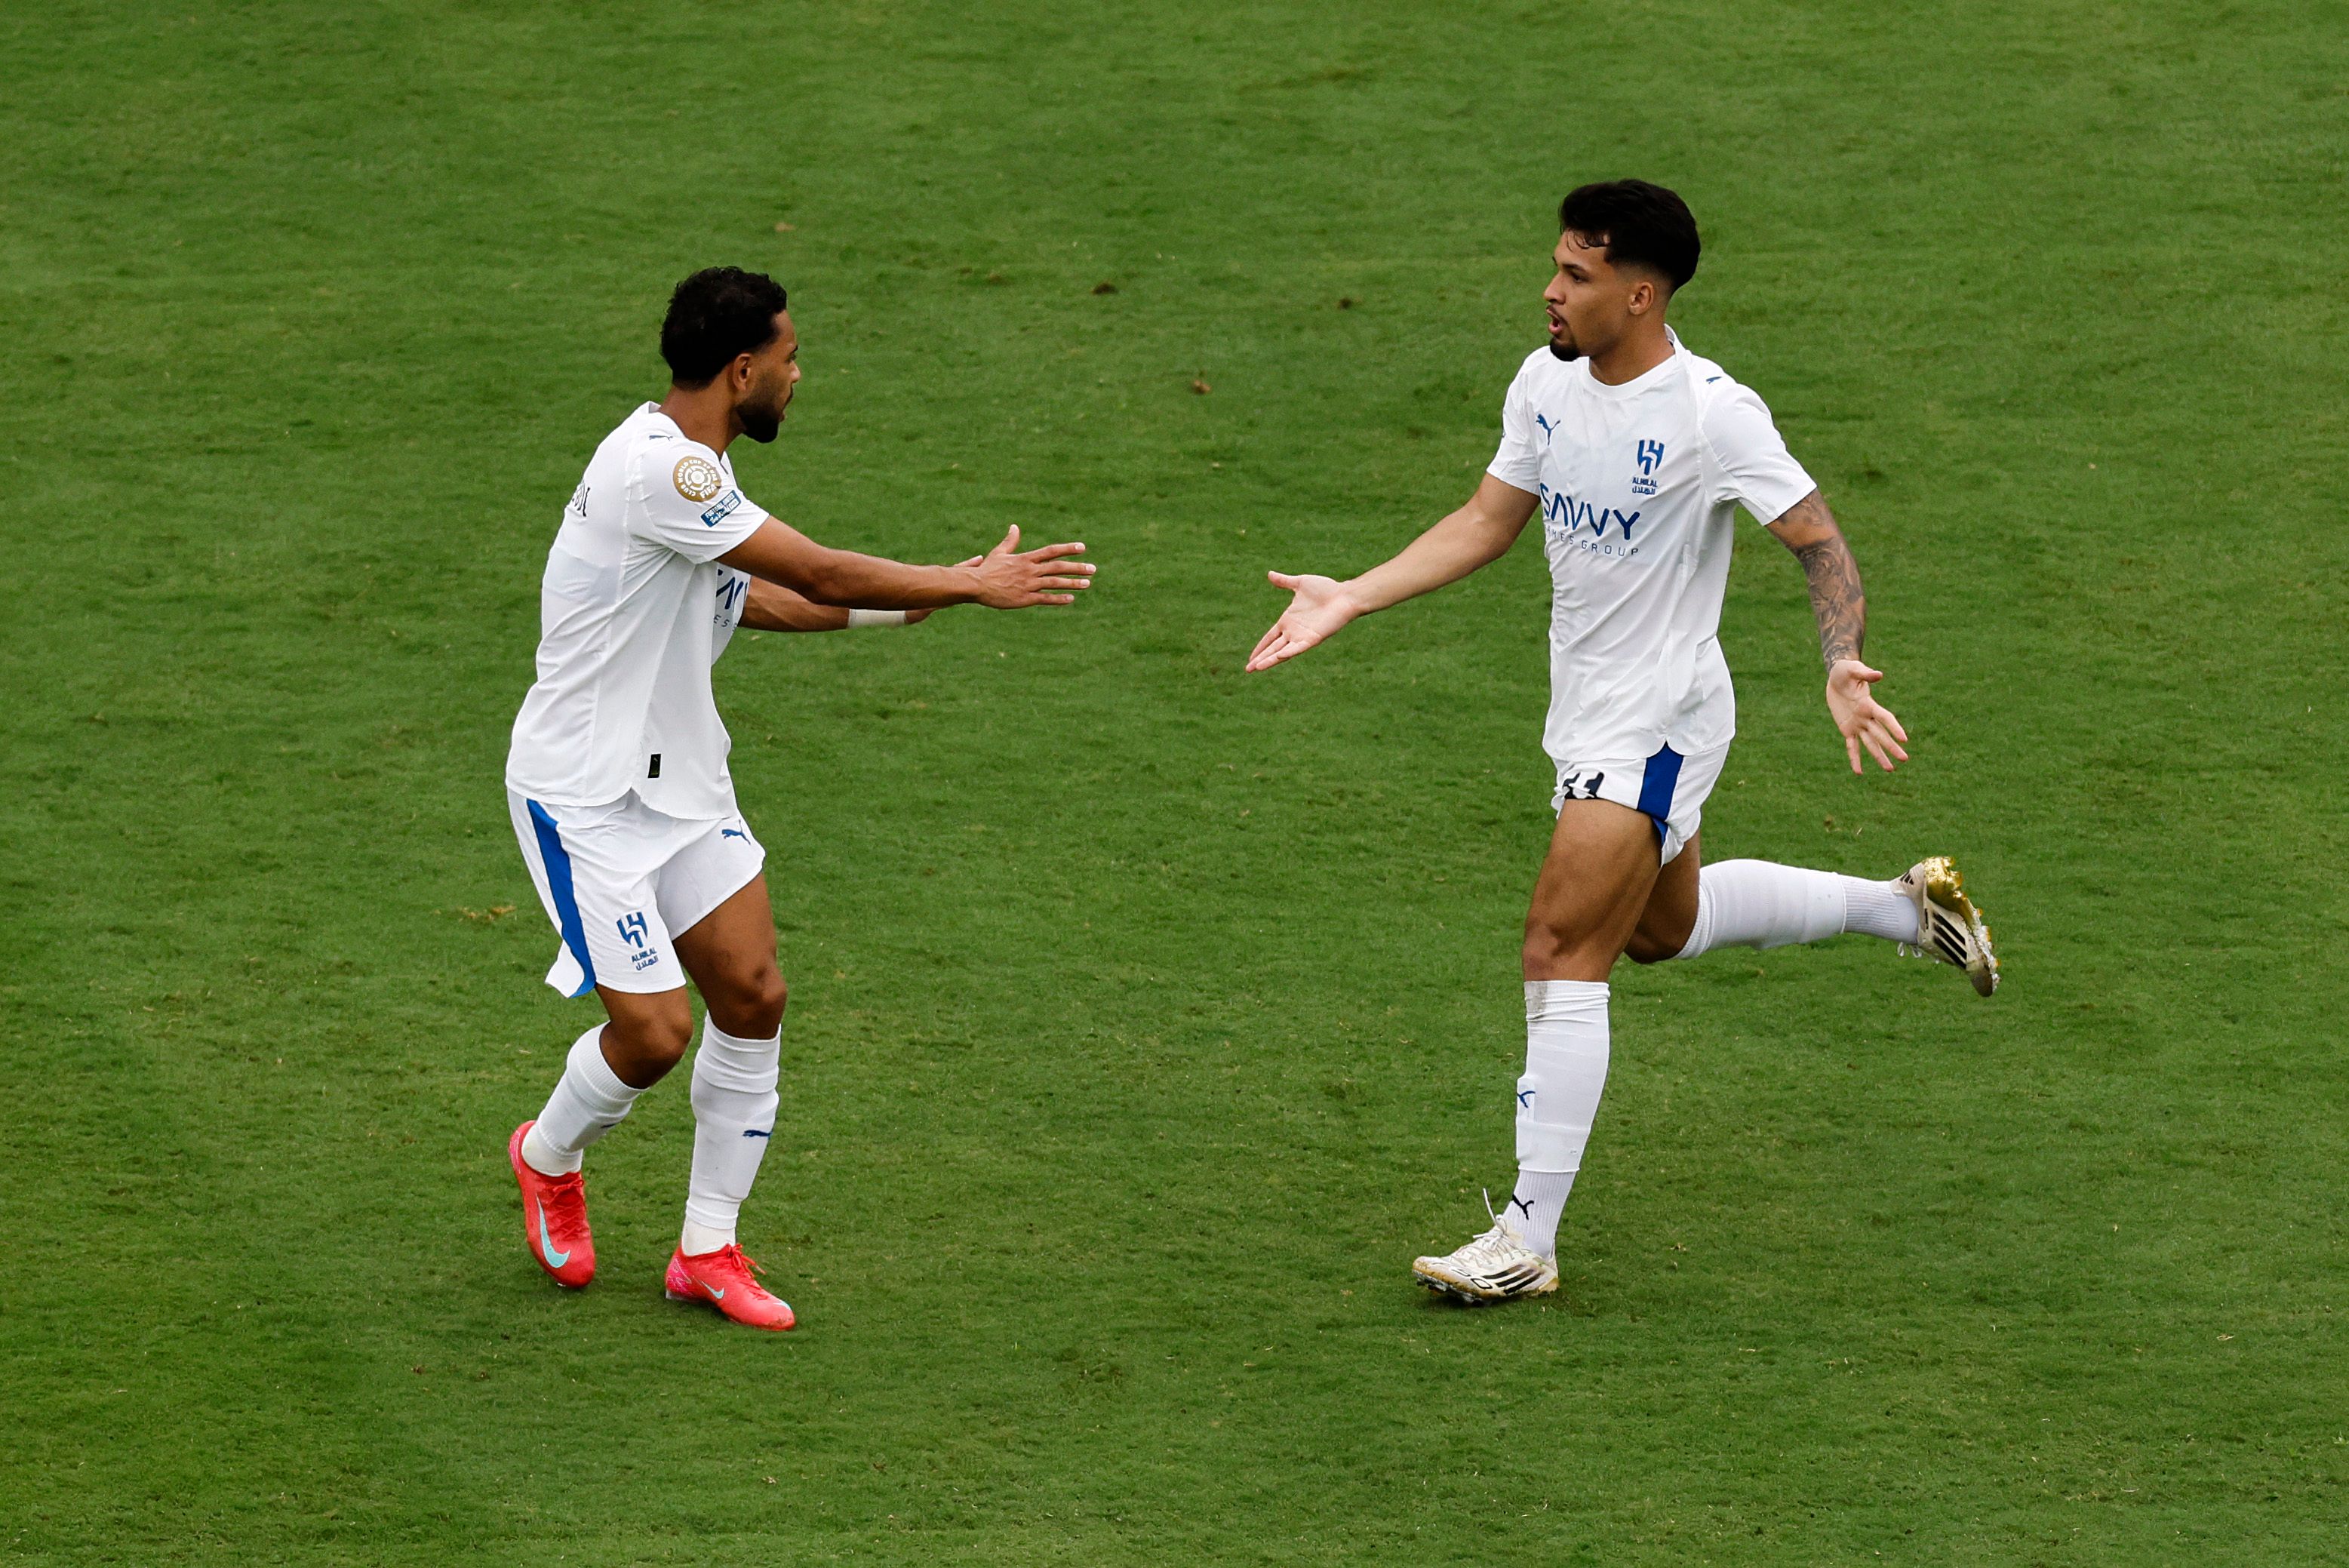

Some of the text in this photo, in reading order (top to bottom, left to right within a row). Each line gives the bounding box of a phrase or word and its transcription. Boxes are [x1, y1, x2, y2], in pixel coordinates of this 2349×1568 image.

[678, 462, 689, 483] WORLD
[681, 484, 696, 497] CLUB
[699, 484, 717, 499] FIFA
[1540, 482, 1640, 540] SAVVY
[1581, 540, 1639, 557] GROUP
